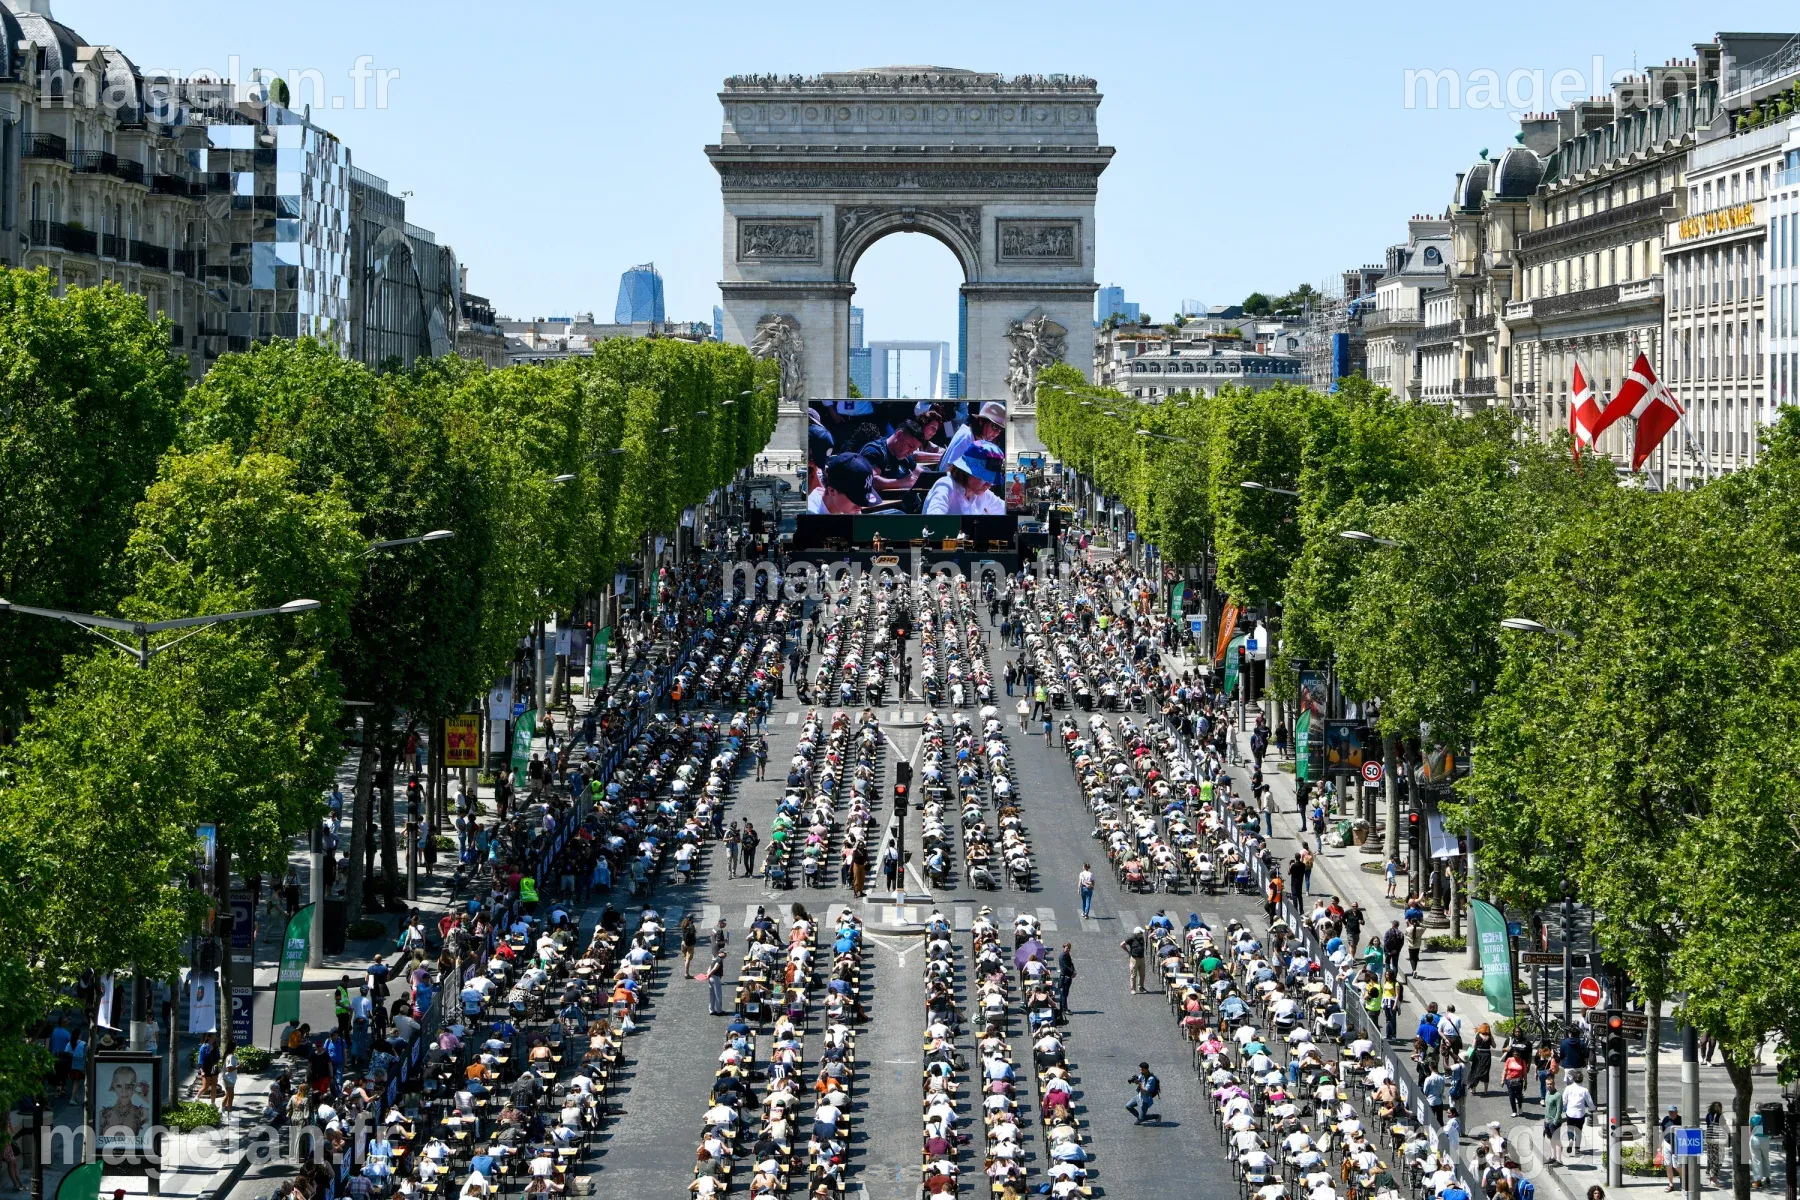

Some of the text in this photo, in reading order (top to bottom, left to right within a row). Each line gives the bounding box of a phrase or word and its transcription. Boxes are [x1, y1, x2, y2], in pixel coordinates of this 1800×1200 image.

[1366, 767, 1378, 776] 50
[775, 1069, 785, 1078] 10
[98, 1136, 150, 1145] SWAROVSKI
[1677, 1137, 1700, 1147] TAXIS
